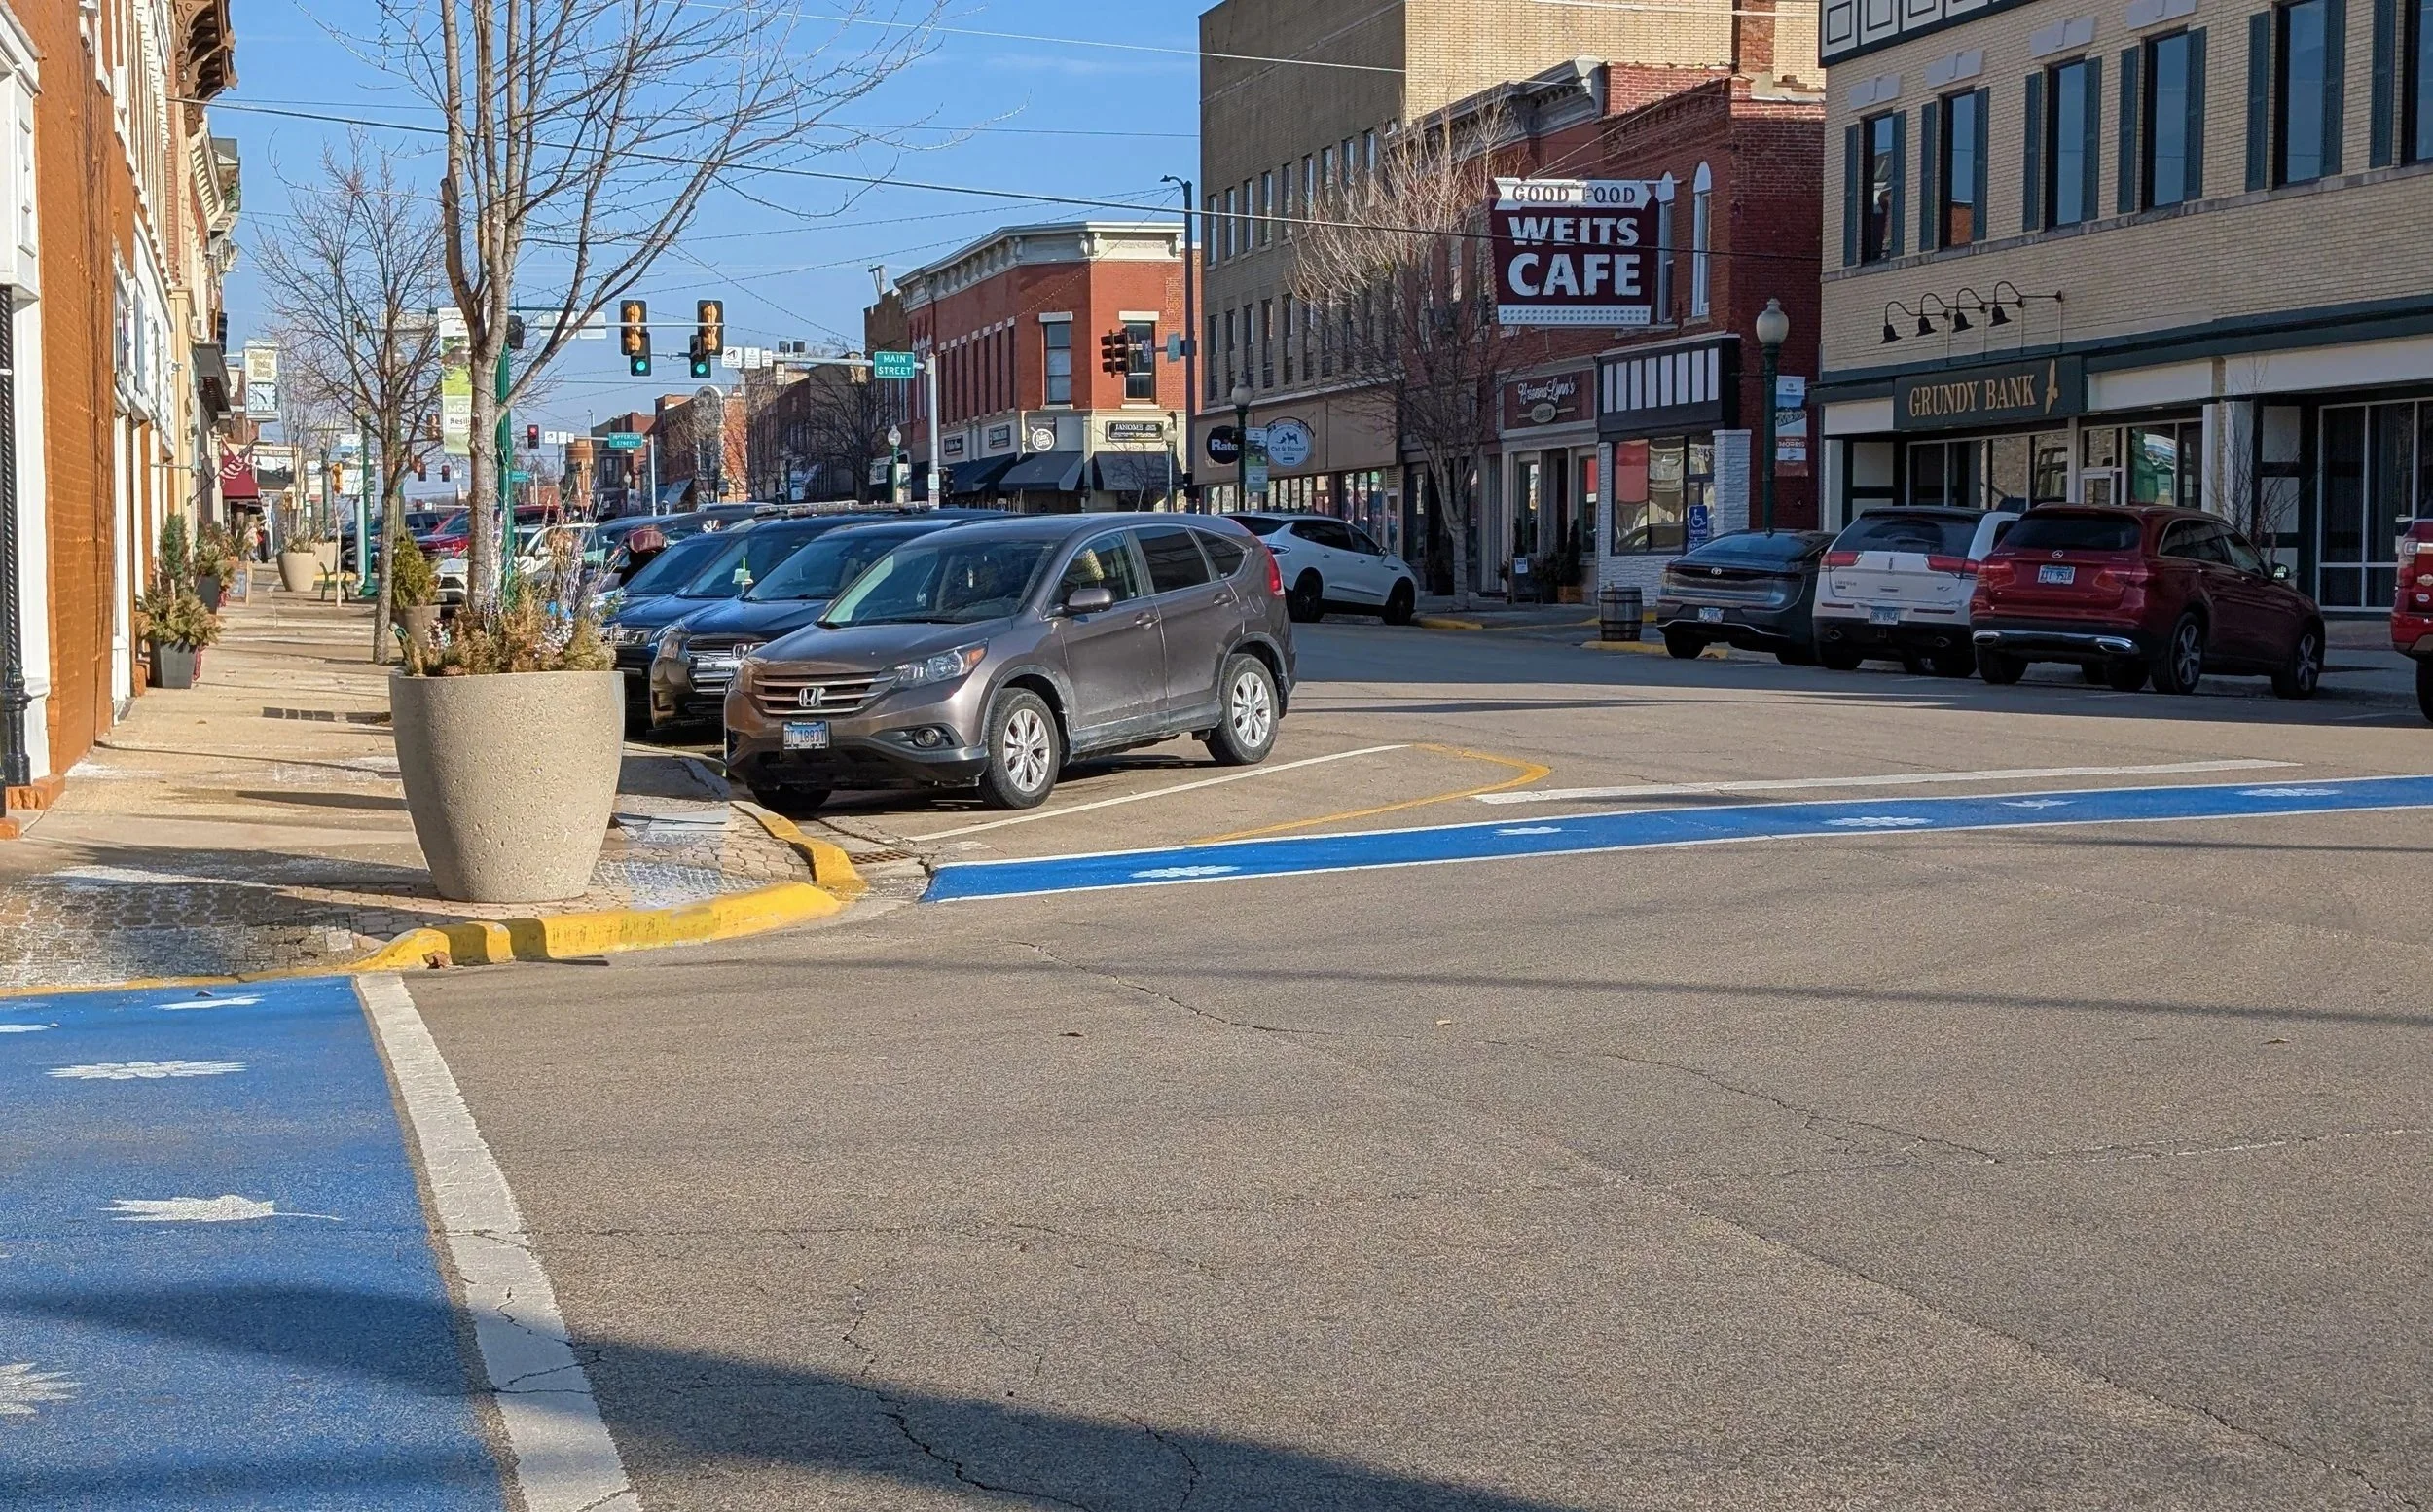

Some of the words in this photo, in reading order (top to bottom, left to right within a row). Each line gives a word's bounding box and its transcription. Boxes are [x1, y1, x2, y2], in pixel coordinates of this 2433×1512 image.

[1512, 185, 1570, 203] GOOD
[1582, 186, 1636, 203] FOOD
[1508, 217, 1639, 247] WEITS
[1507, 253, 1642, 297] CAFE
[883, 354, 906, 364] MAIN
[878, 366, 911, 376] STREET
[1908, 380, 1979, 417] GRUNDY
[1984, 374, 2037, 411] BANK
[1211, 438, 1239, 451] Rate
